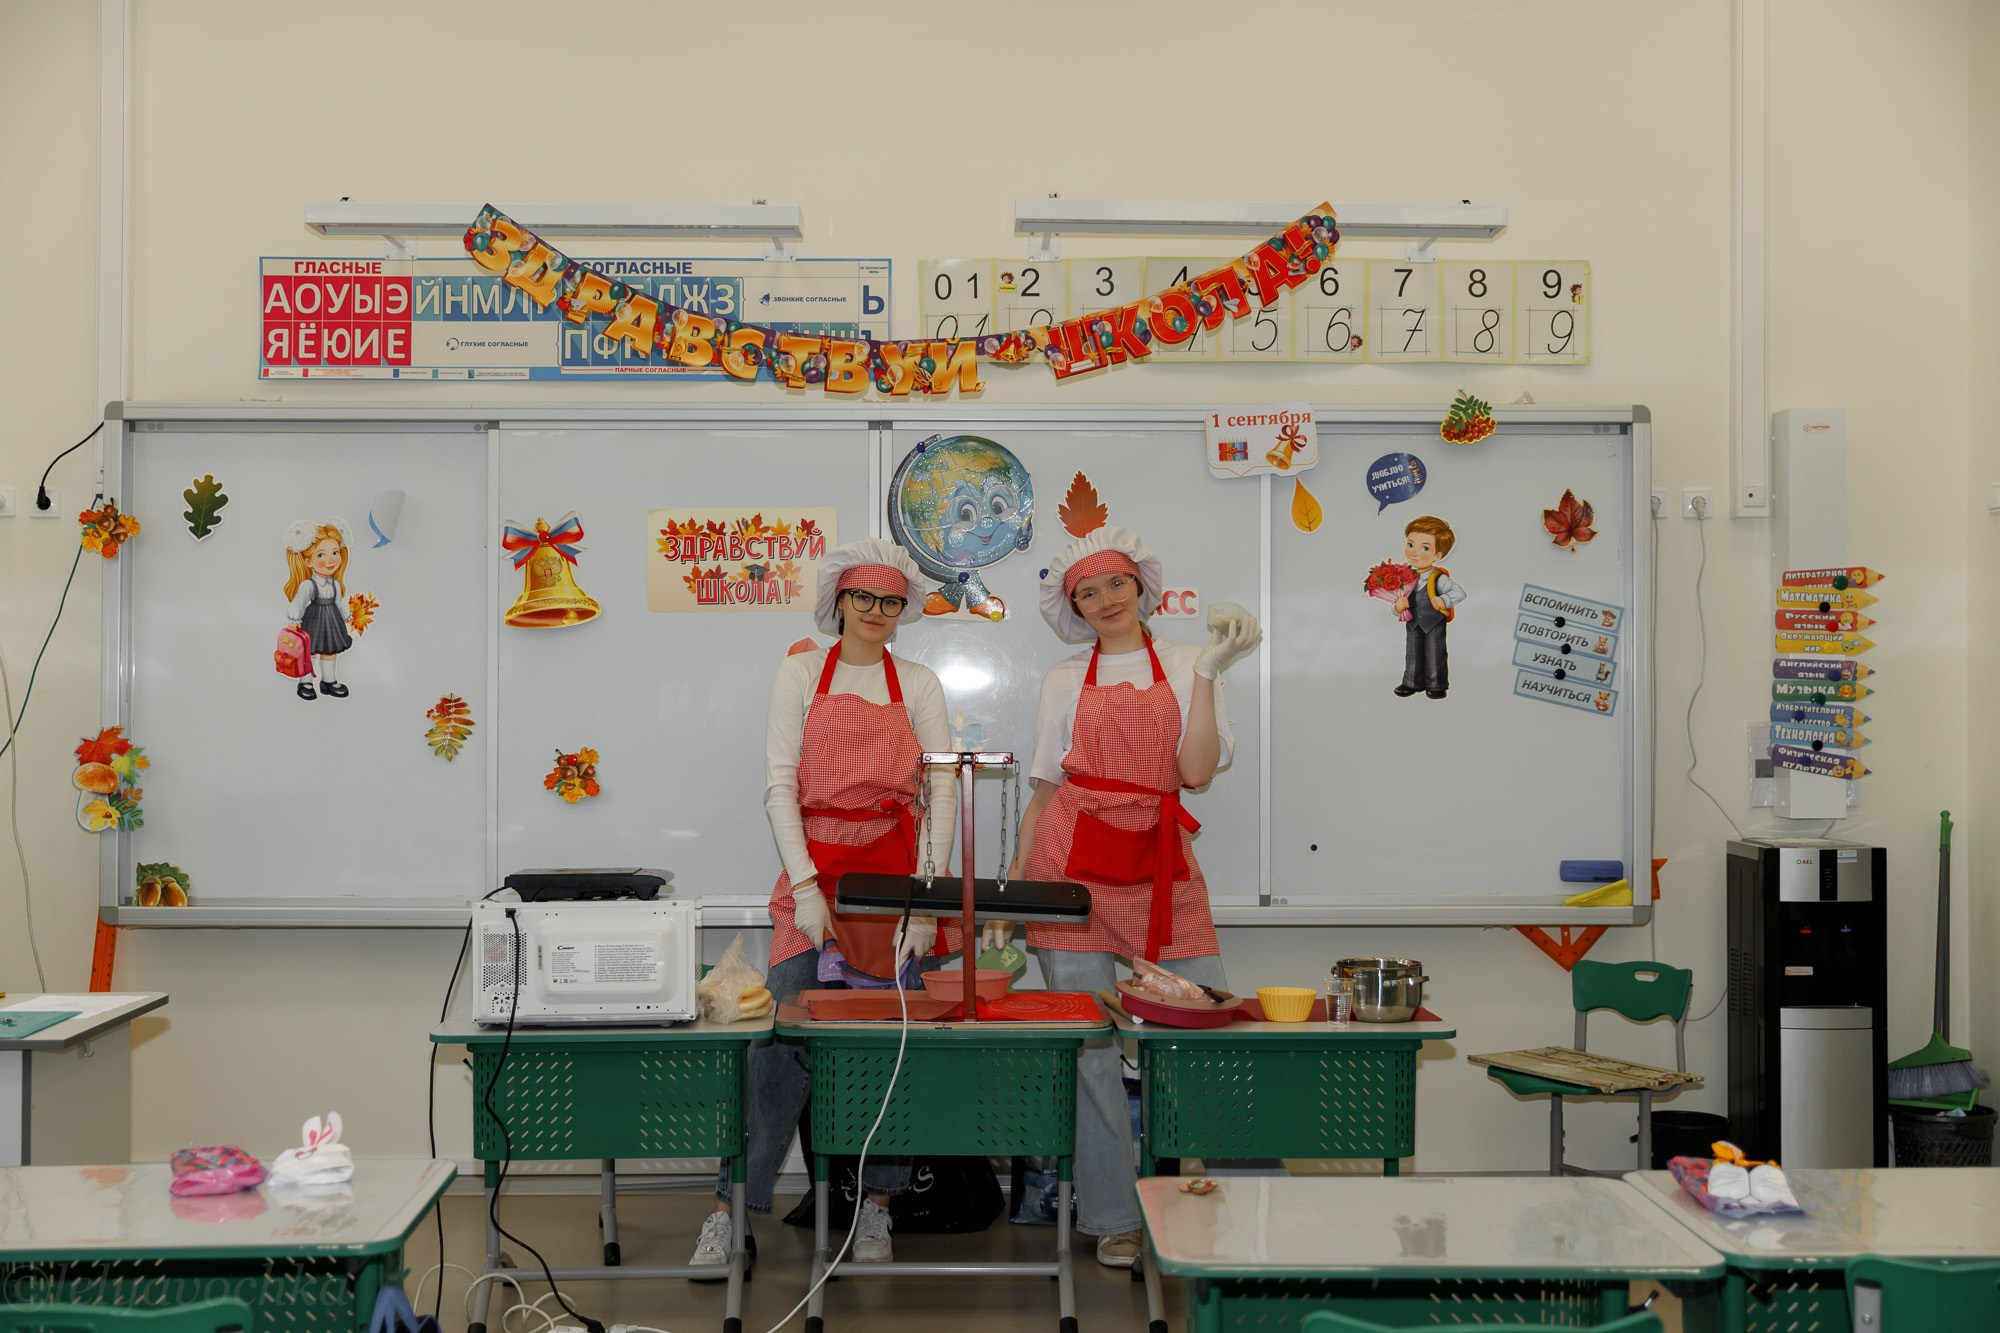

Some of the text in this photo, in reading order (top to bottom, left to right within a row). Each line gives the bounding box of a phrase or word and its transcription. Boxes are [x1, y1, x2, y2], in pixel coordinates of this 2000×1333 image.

[294, 261, 382, 275] ГЛАСНЫЕ
[581, 261, 693, 275] СОГЛАСНЫЕ
[934, 273, 951, 301] 0
[967, 272, 979, 300] 1
[1021, 268, 1040, 297] 2
[1095, 267, 1115, 297] 3
[1320, 267, 1339, 296] 6
[1394, 268, 1413, 297] 7
[1468, 269, 1488, 298] 8
[1542, 270, 1562, 299] 9
[863, 285, 885, 315] Ь
[1252, 308, 1278, 351] 5
[1326, 308, 1351, 352] 6
[1403, 308, 1426, 352] 7
[1474, 309, 1500, 353] 8
[1547, 310, 1574, 354] 9
[1212, 410, 1312, 428] 1 сентября
[1371, 464, 1404, 480] ЛЮБЛЮ
[1371, 475, 1410, 493] УЧИТЬСЯ!
[664, 528, 826, 564] ЗДРАВСТВУЙ
[695, 579, 792, 605] ШКОЛА!
[1155, 590, 1197, 615] СС
[1524, 593, 1599, 620] ВСПОМНИТЬ
[1519, 622, 1589, 647] ПОВТОРИТЬ
[1533, 652, 1577, 671] УЗНАТЬ
[1522, 679, 1592, 703] НАУЧИТЬСЯ
